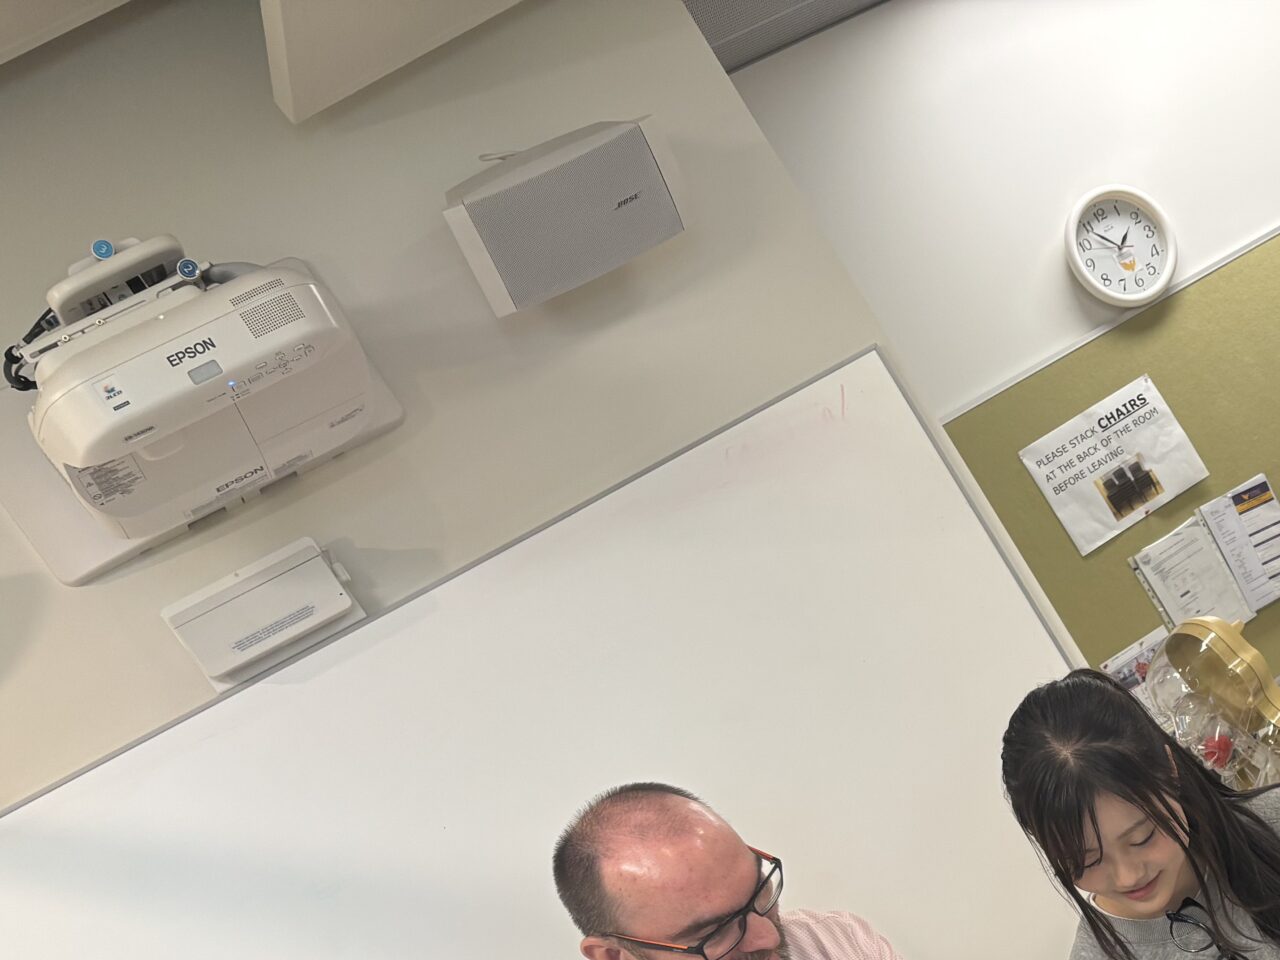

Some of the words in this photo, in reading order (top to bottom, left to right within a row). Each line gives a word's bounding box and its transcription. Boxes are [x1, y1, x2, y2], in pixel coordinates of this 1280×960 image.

[1093, 208, 1108, 223] 12
[1114, 205, 1121, 216] 1
[1130, 211, 1142, 225] 2
[1143, 224, 1155, 239] 3
[1079, 238, 1092, 253] 10
[1151, 244, 1160, 258] 4
[1085, 258, 1096, 272] 9
[1146, 262, 1157, 276] 5
[1101, 273, 1112, 287] 8
[1119, 278, 1127, 291] 7
[166, 336, 216, 368] EPSON
[1035, 443, 1068, 468] PLEASE
[1068, 426, 1098, 448] STACK
[1096, 393, 1148, 429] CHAIRS
[1044, 470, 1057, 482] AT
[1057, 458, 1076, 474] THE
[1076, 444, 1100, 462] BACK
[1100, 434, 1114, 447] OF
[1114, 423, 1131, 438] THE
[1132, 407, 1159, 427] ROOM
[1052, 469, 1087, 495] BEFORE
[1087, 446, 1124, 473] LEAVING
[215, 465, 265, 494] EPSON
